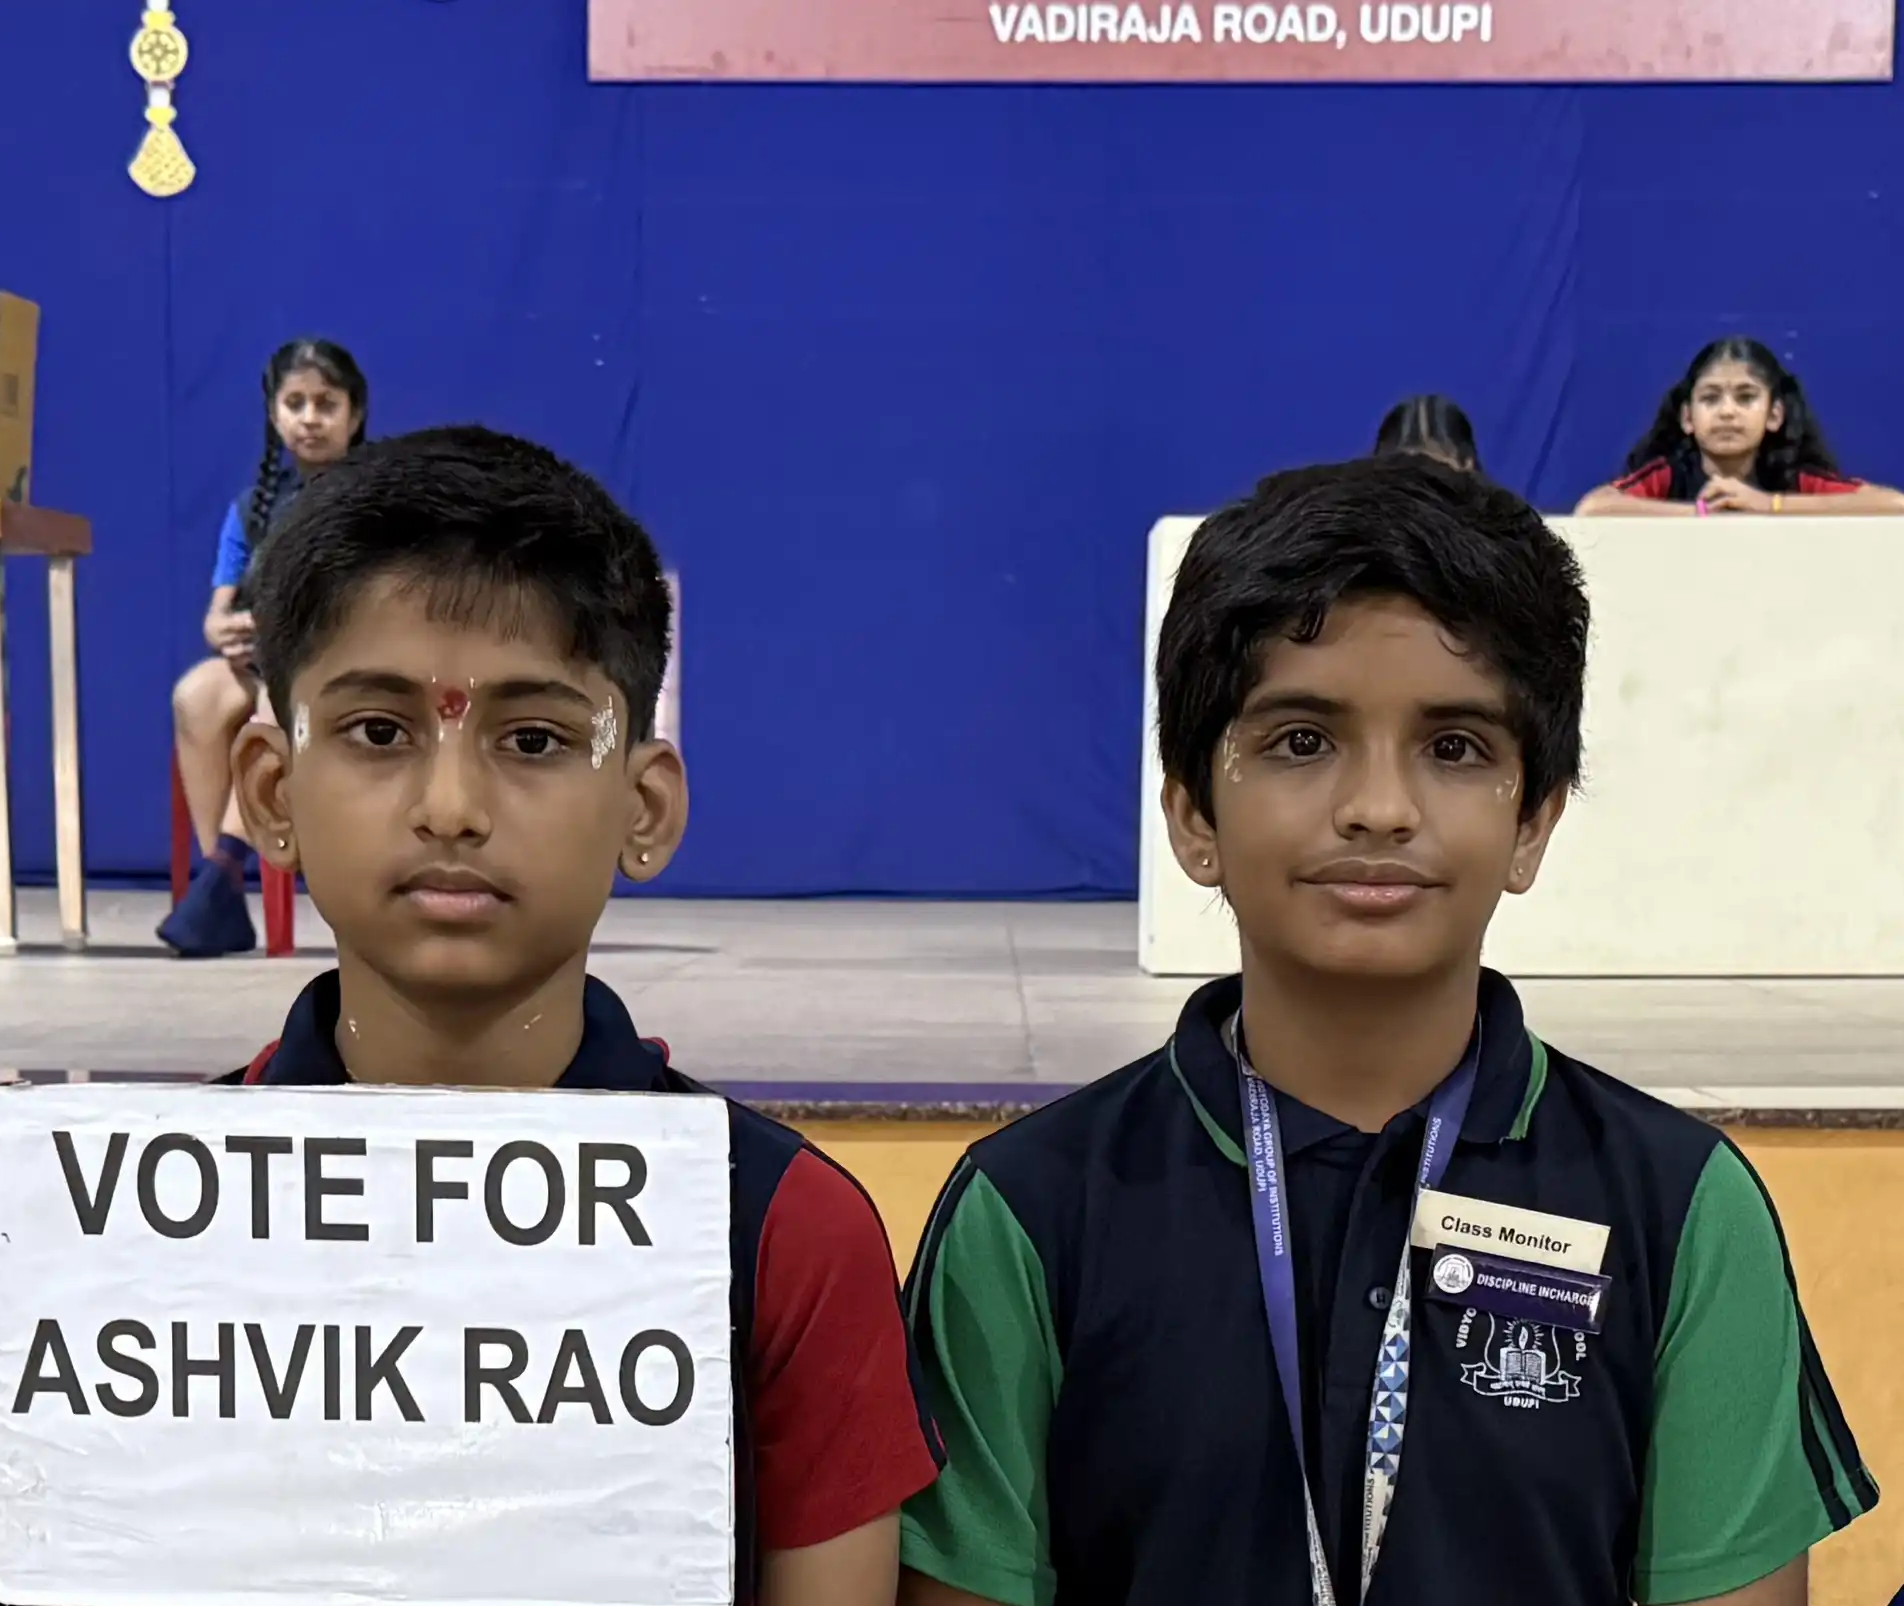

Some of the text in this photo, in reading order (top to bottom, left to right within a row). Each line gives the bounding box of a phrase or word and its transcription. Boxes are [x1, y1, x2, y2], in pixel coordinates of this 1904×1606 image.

[989, 3, 1493, 50] VADIRAJA ROAD, UDUPI
[51, 1130, 654, 1247] VOTE FOR
[1440, 1214, 1572, 1254] Class Monitor
[1476, 1273, 1537, 1296] DISCIPLINE
[1455, 1307, 1477, 1348] VIDYO
[1573, 1331, 1587, 1361] OOL
[11, 1318, 695, 1427] ASHVIK RAO
